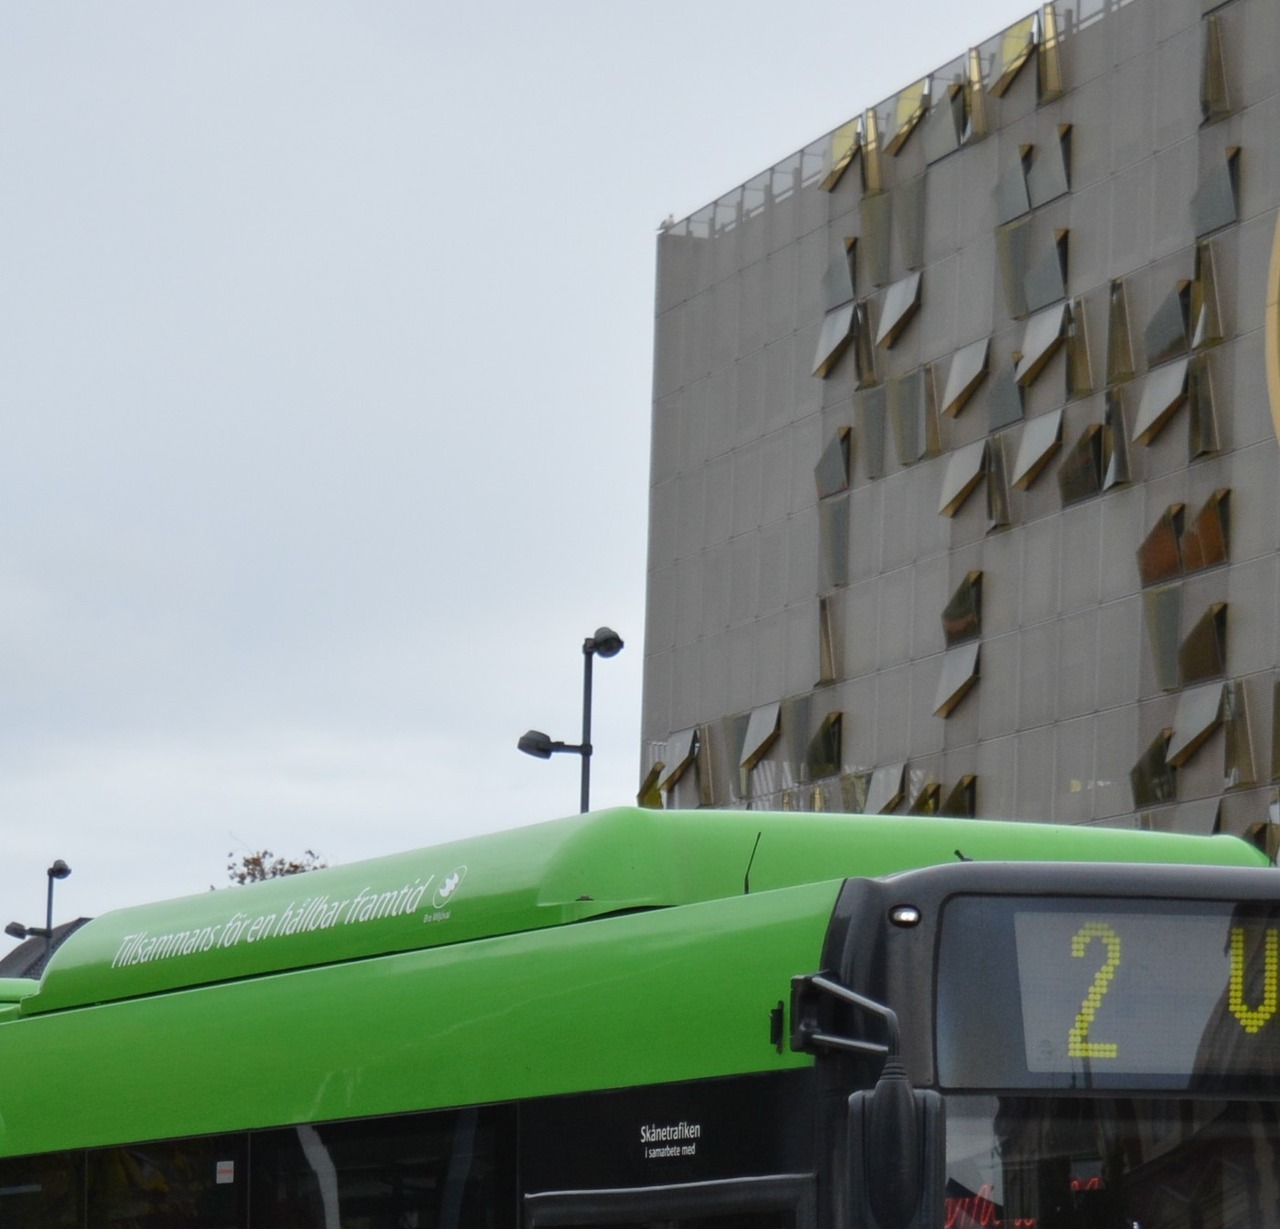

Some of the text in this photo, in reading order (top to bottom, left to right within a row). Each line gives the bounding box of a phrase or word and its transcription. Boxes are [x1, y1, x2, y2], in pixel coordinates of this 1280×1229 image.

[111, 875, 435, 968] Tillsammans för en hållbar framtid
[1068, 922, 1121, 1058] 2
[640, 1121, 701, 1143] Skånetrafiken
[648, 1144, 681, 1159] samarbete
[681, 1142, 696, 1156] med
